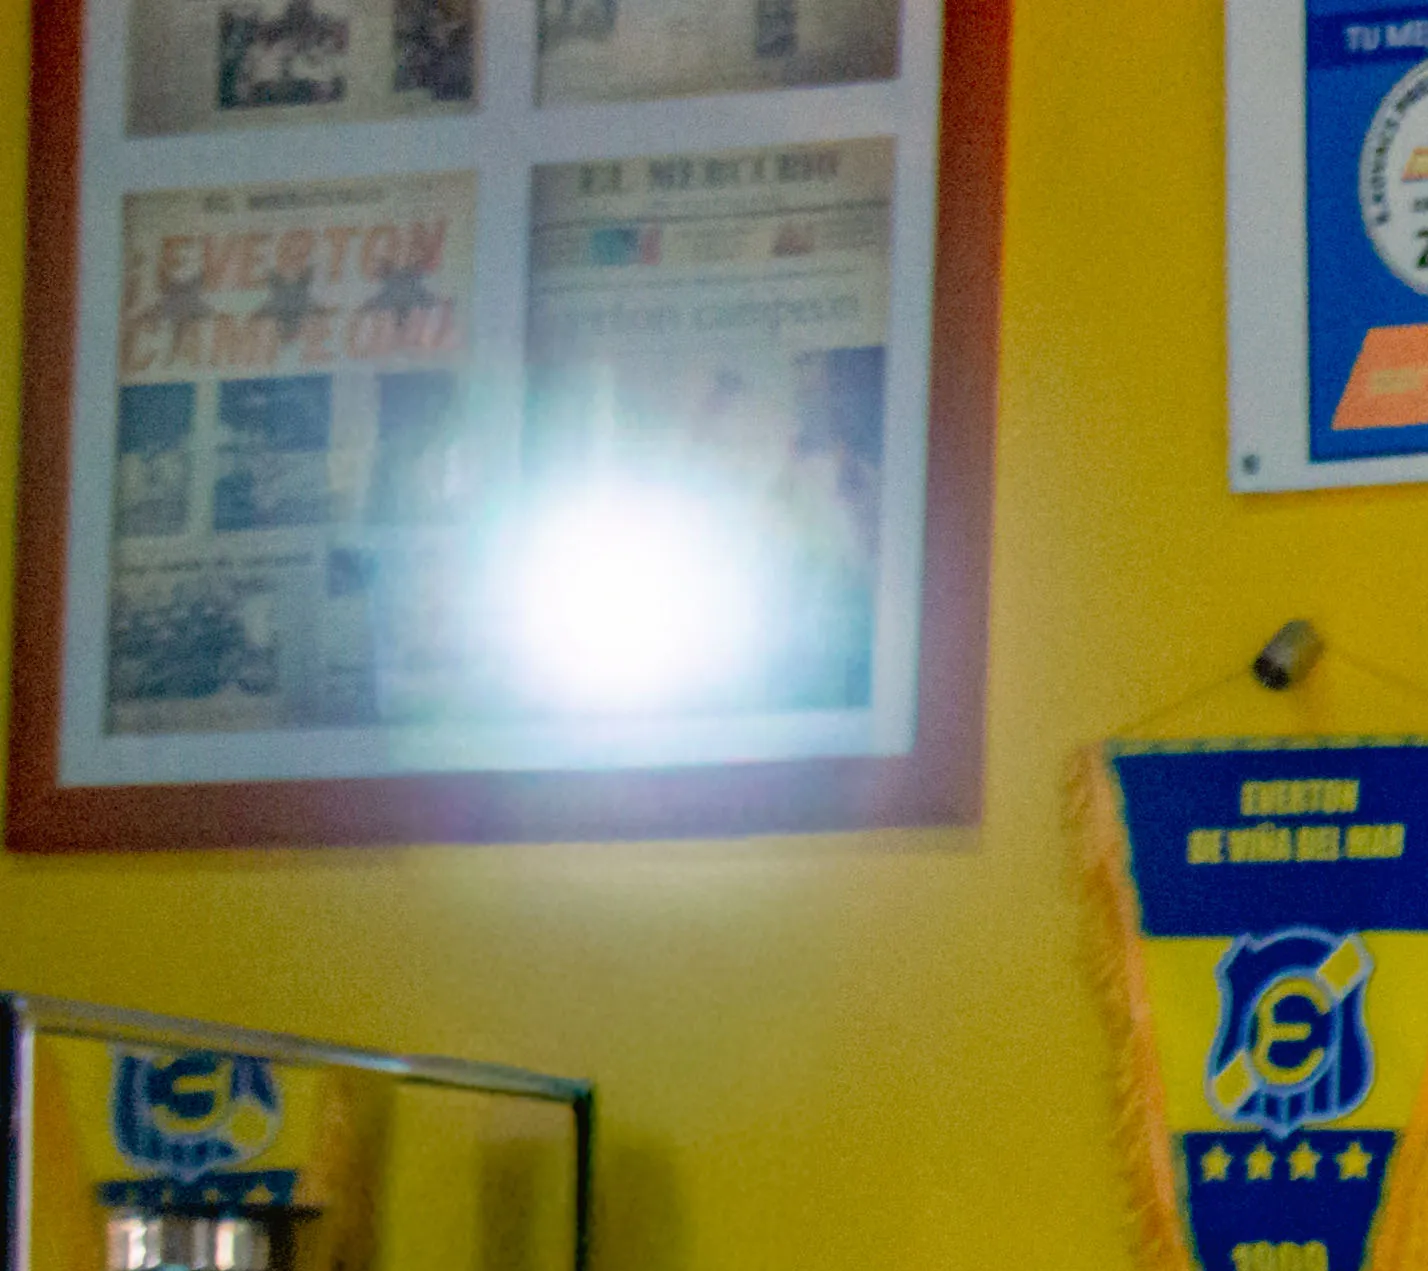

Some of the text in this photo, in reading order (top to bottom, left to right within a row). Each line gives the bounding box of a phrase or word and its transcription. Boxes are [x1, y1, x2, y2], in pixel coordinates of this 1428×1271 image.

[1347, 26, 1381, 51] TU
[1240, 778, 1360, 817] EVERTON
[1187, 820, 1405, 864] DE VIÑA DEL MAR
